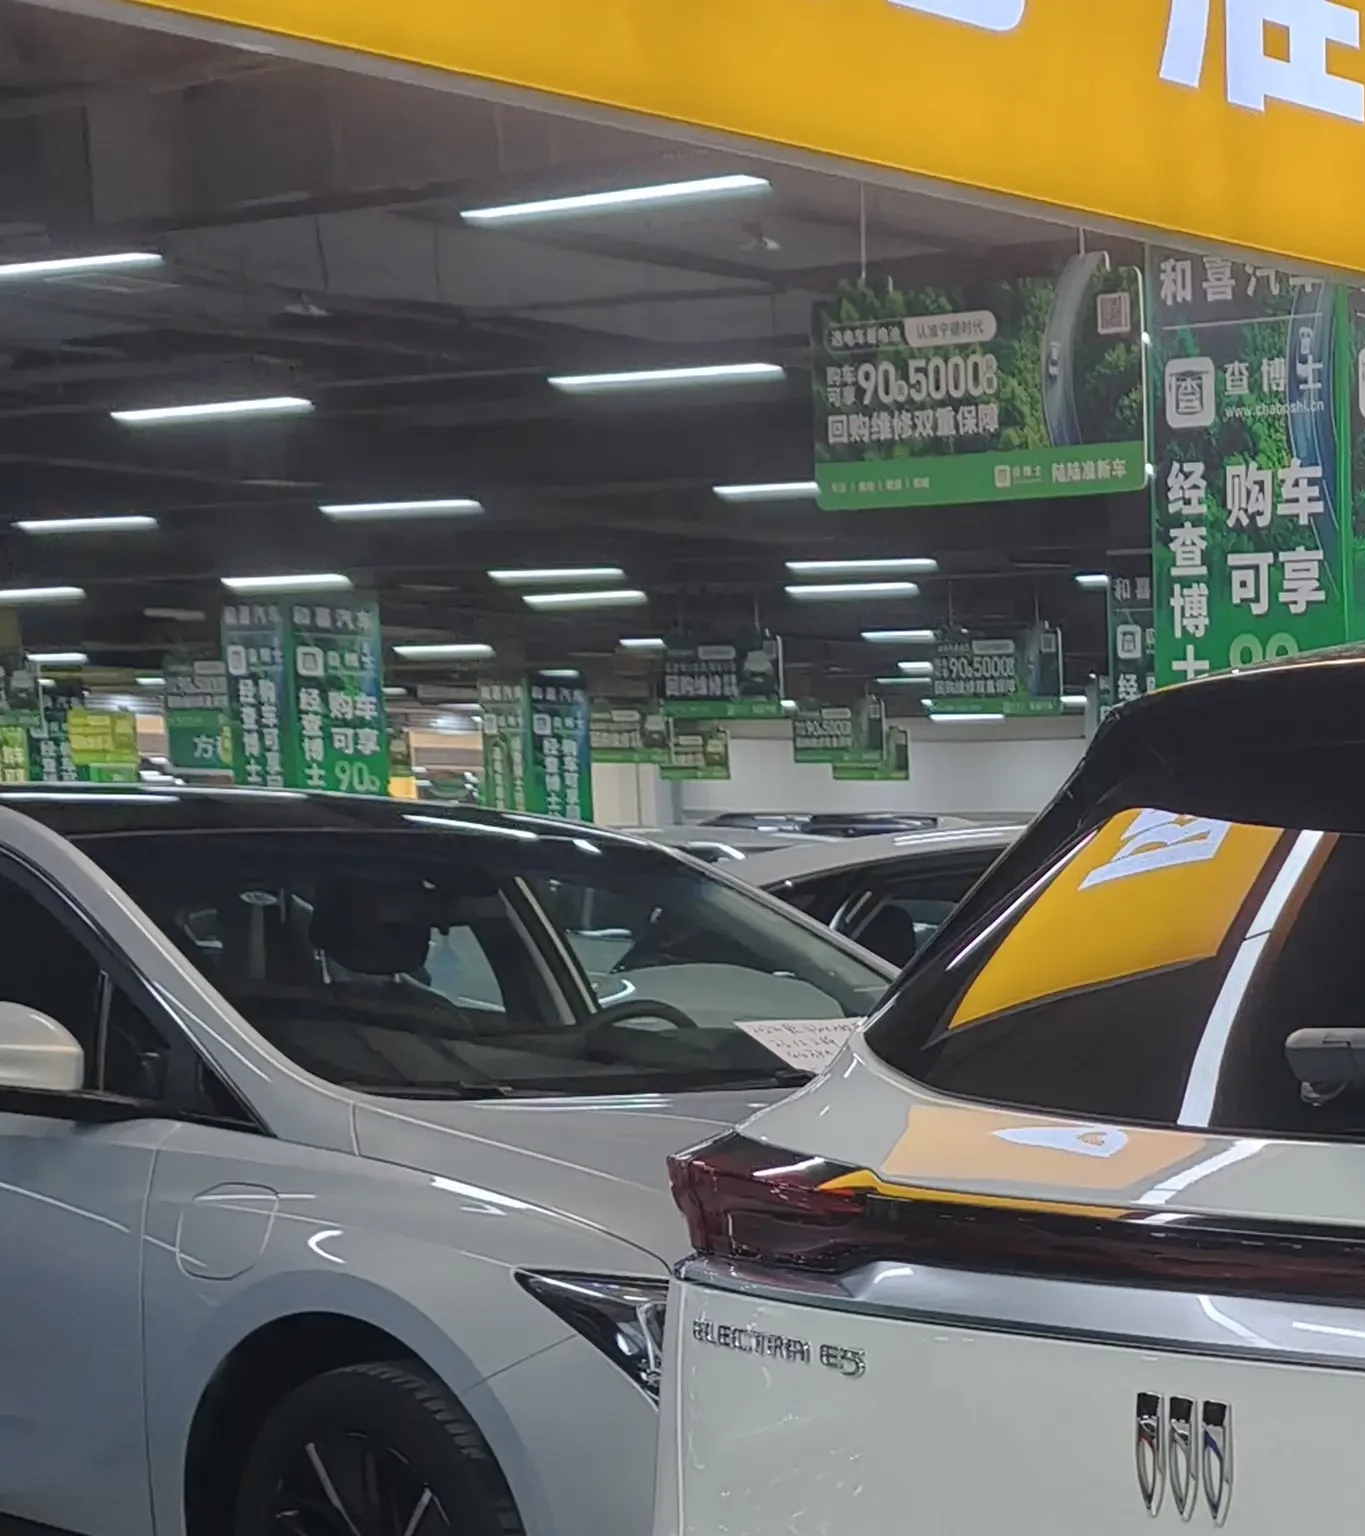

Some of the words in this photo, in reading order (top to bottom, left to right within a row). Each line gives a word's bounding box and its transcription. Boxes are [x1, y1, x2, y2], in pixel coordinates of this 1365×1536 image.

[1160, 256, 1326, 306] 和喜汽
[1223, 353, 1324, 397] 查博士
[827, 402, 998, 446] 回购维修双重保障
[1224, 399, 1325, 419] www.chaboshi.cn
[1225, 459, 1326, 528] 购车
[1226, 549, 1327, 616] 可享
